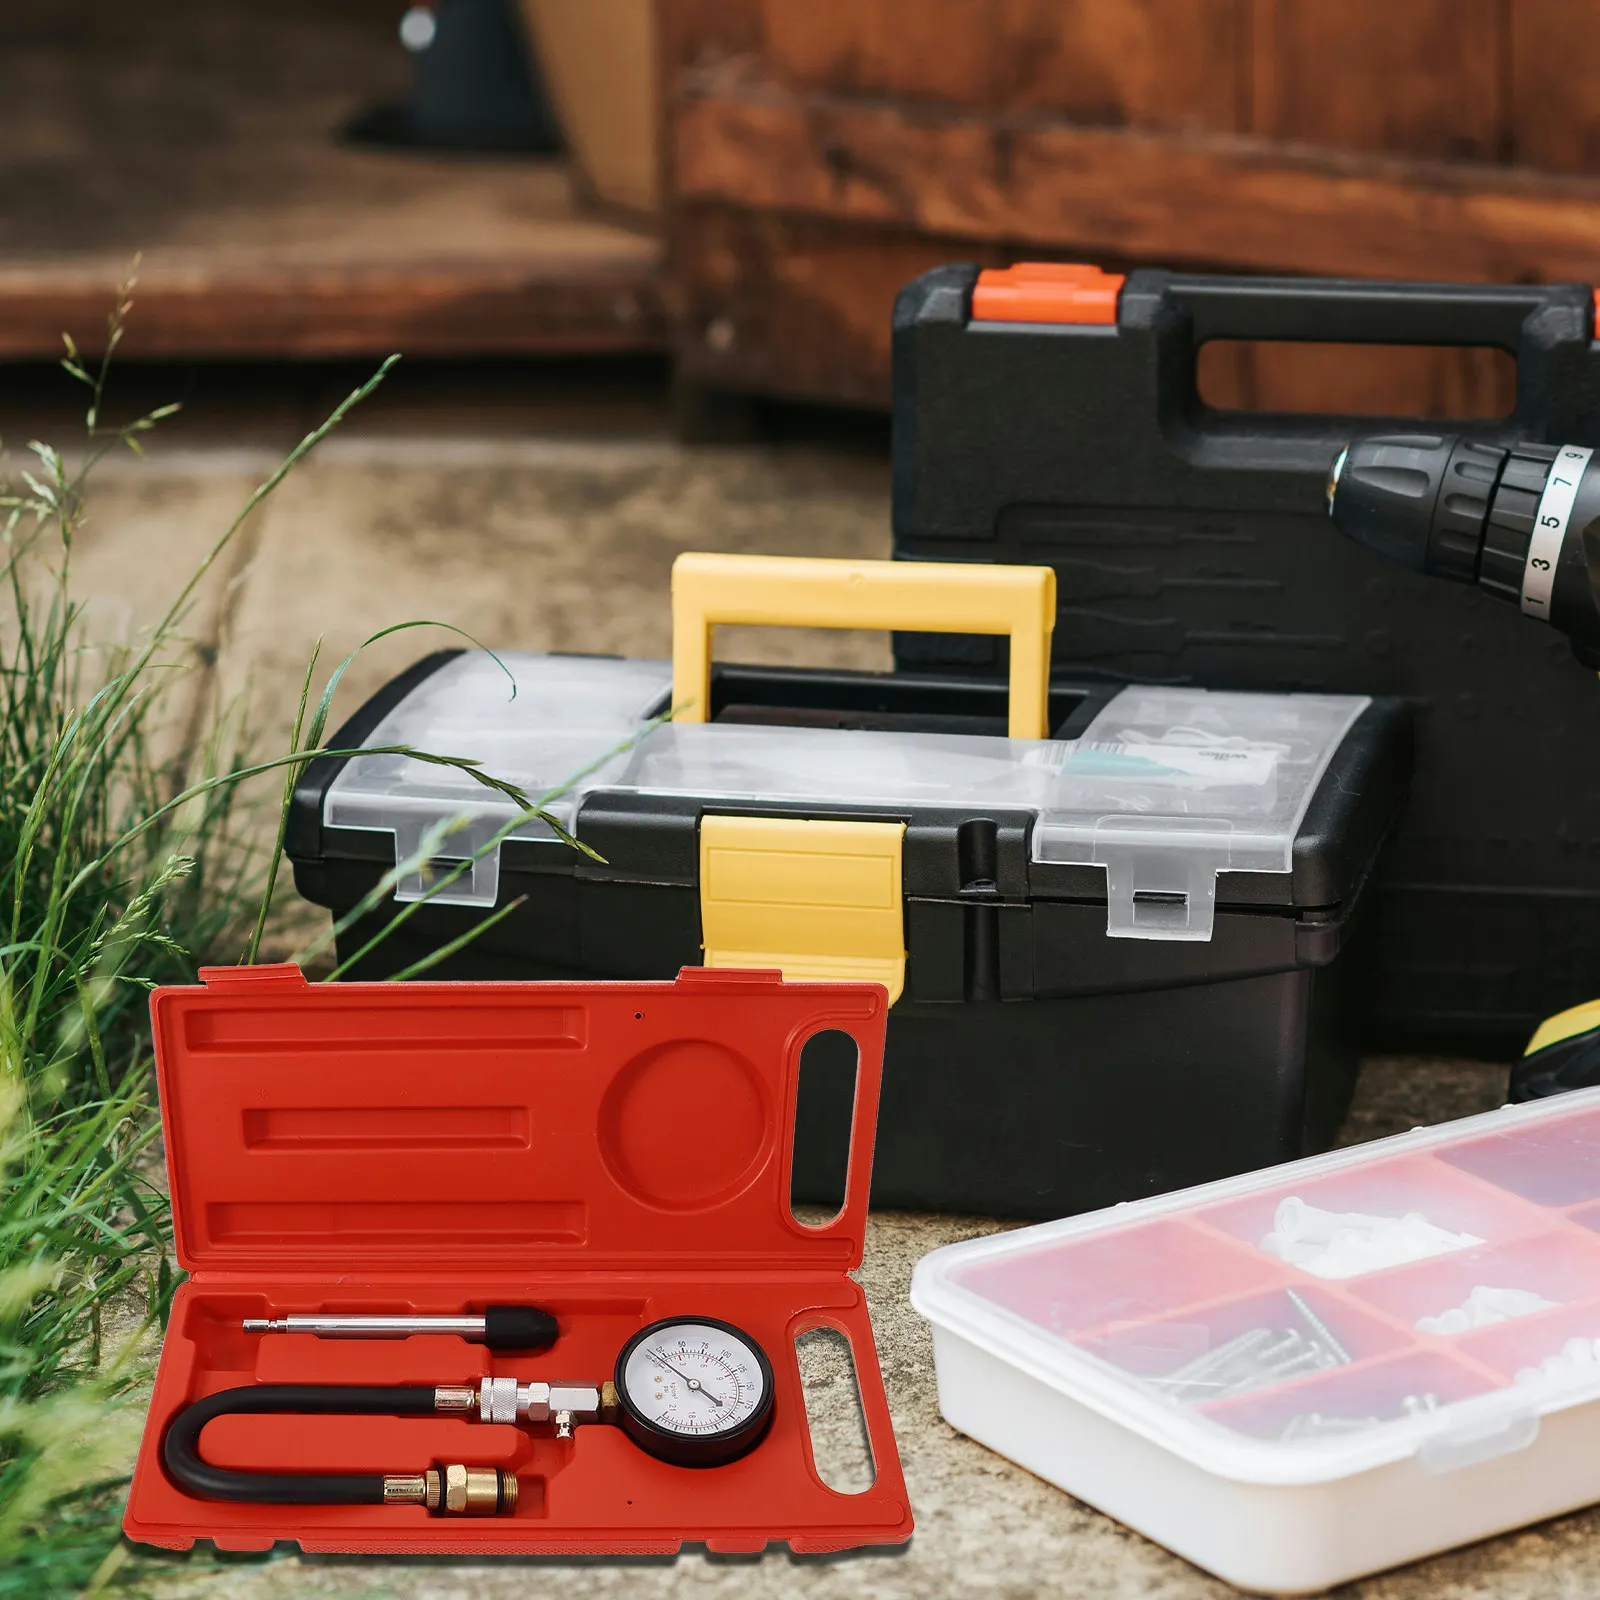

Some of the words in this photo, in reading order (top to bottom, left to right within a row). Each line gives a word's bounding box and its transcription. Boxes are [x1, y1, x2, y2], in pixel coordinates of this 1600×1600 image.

[1553, 477, 1572, 487] 7
[1540, 515, 1560, 528] 5
[1531, 559, 1550, 571] 3
[721, 1350, 732, 1358] 100
[737, 1363, 747, 1373] 125
[746, 1382, 754, 1390] 150
[745, 1401, 754, 1410] 175
